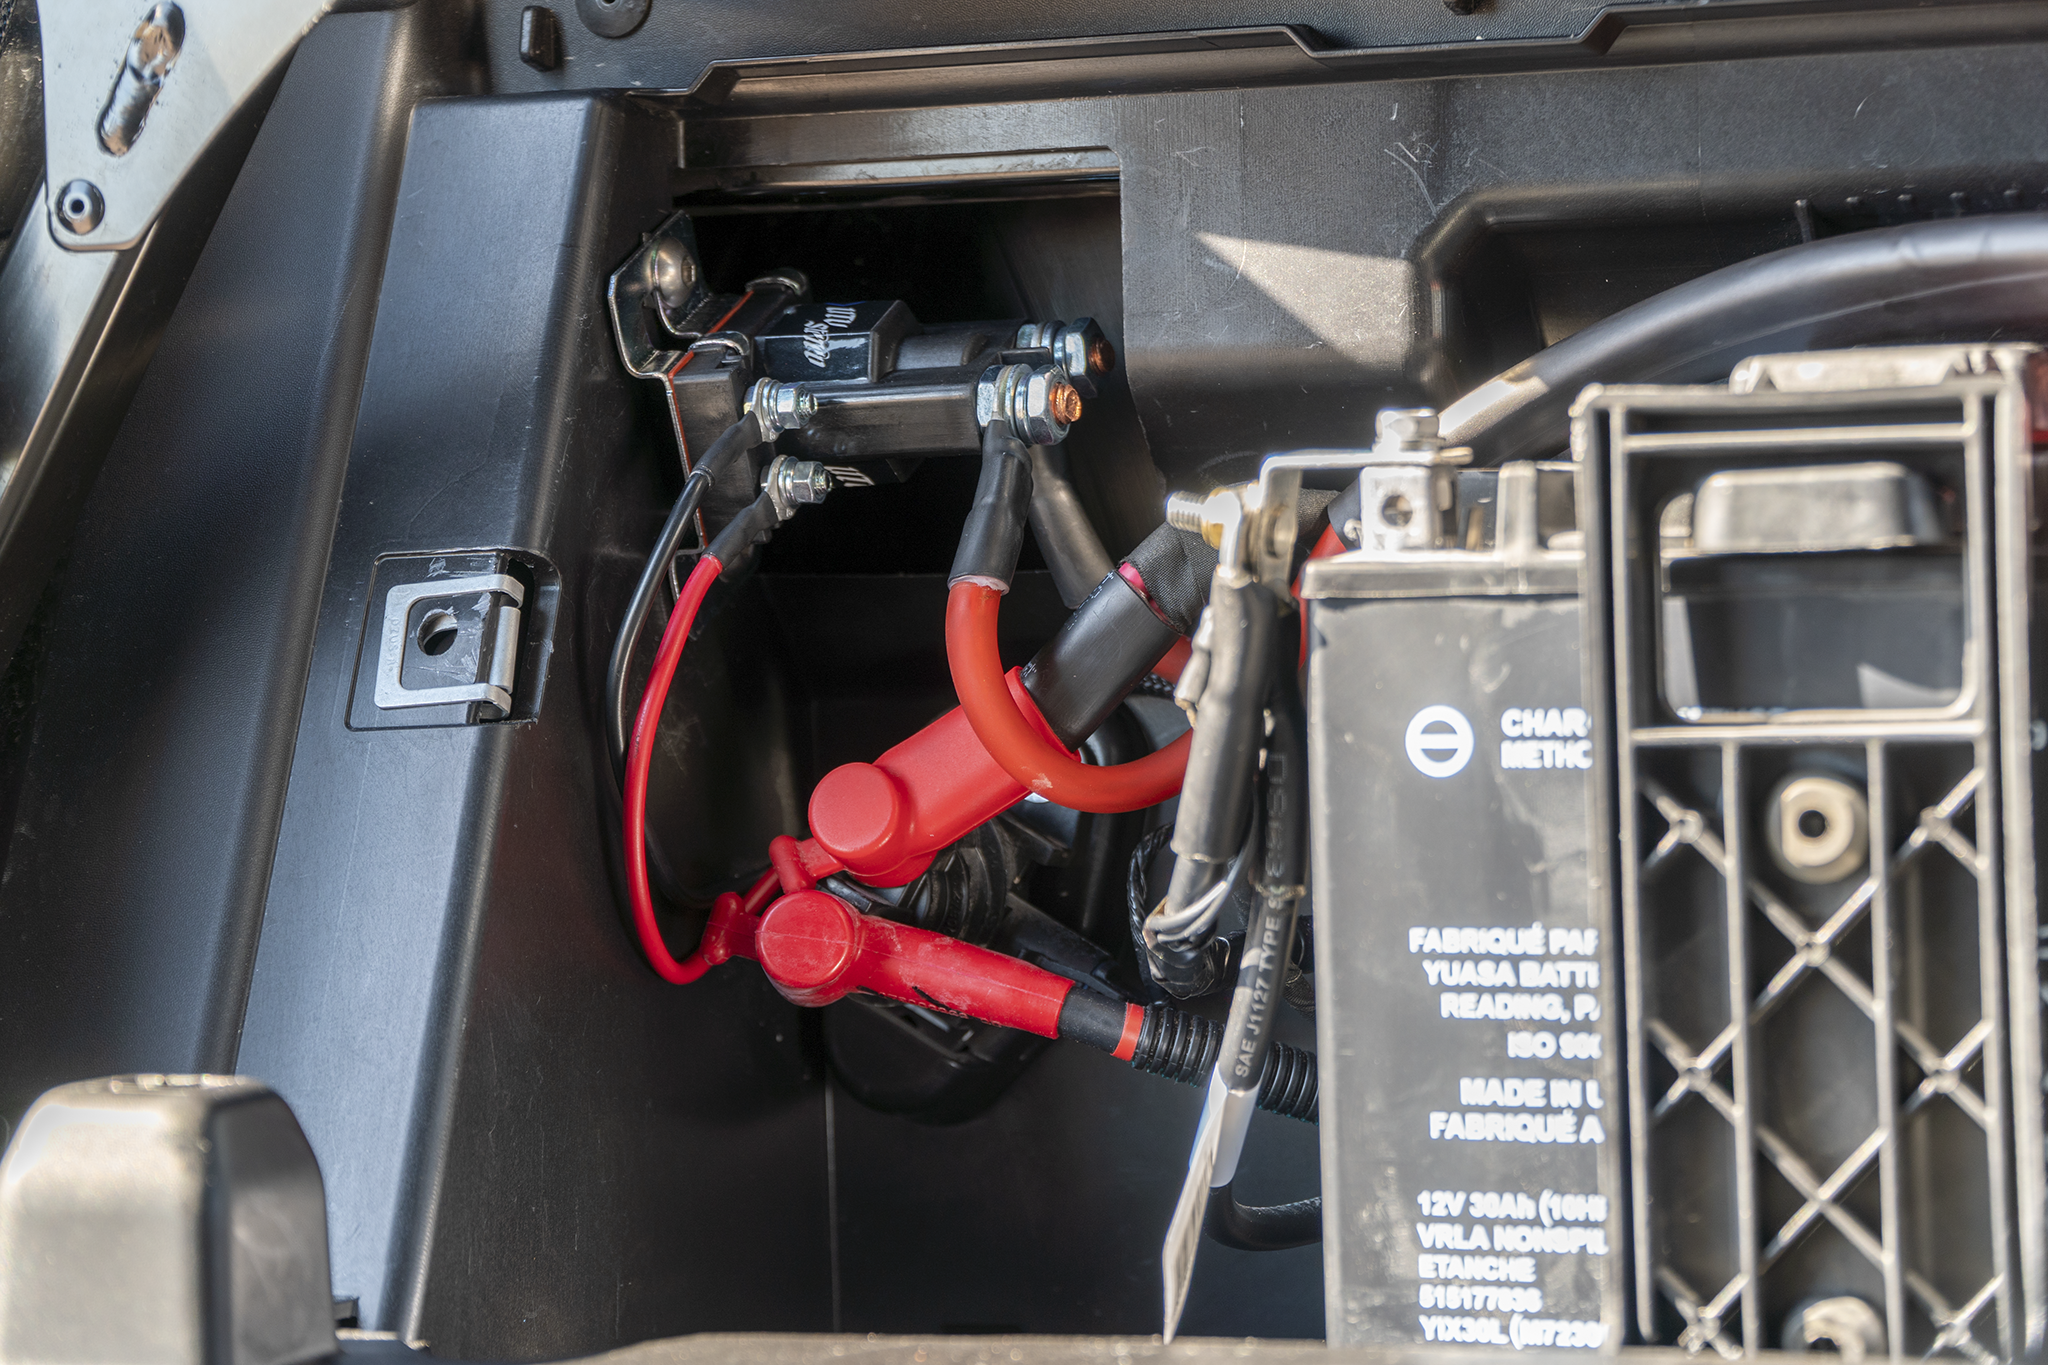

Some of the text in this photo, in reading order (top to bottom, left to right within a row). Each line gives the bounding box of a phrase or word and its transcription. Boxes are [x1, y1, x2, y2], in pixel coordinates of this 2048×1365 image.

[1500, 707, 1593, 737] CHAR
[1408, 921, 1546, 956] FABRIQUÉ
[1422, 959, 1517, 987] YUASA
[1234, 1037, 1258, 1078] SAE
[1246, 976, 1270, 1036] J1127
[1258, 915, 1281, 973] TYPE
[1440, 992, 1571, 1024] READING,
[1507, 1031, 1557, 1059] ISO
[1460, 1078, 1547, 1107] MADE
[1549, 1079, 1582, 1108] IN
[1429, 1108, 1577, 1143] FABRIQUÉ
[1417, 1190, 1467, 1217] 12V
[1469, 1191, 1536, 1220] 30Ah
[1416, 1222, 1491, 1251] VRLA
[1418, 1253, 1537, 1283] ETANCHE
